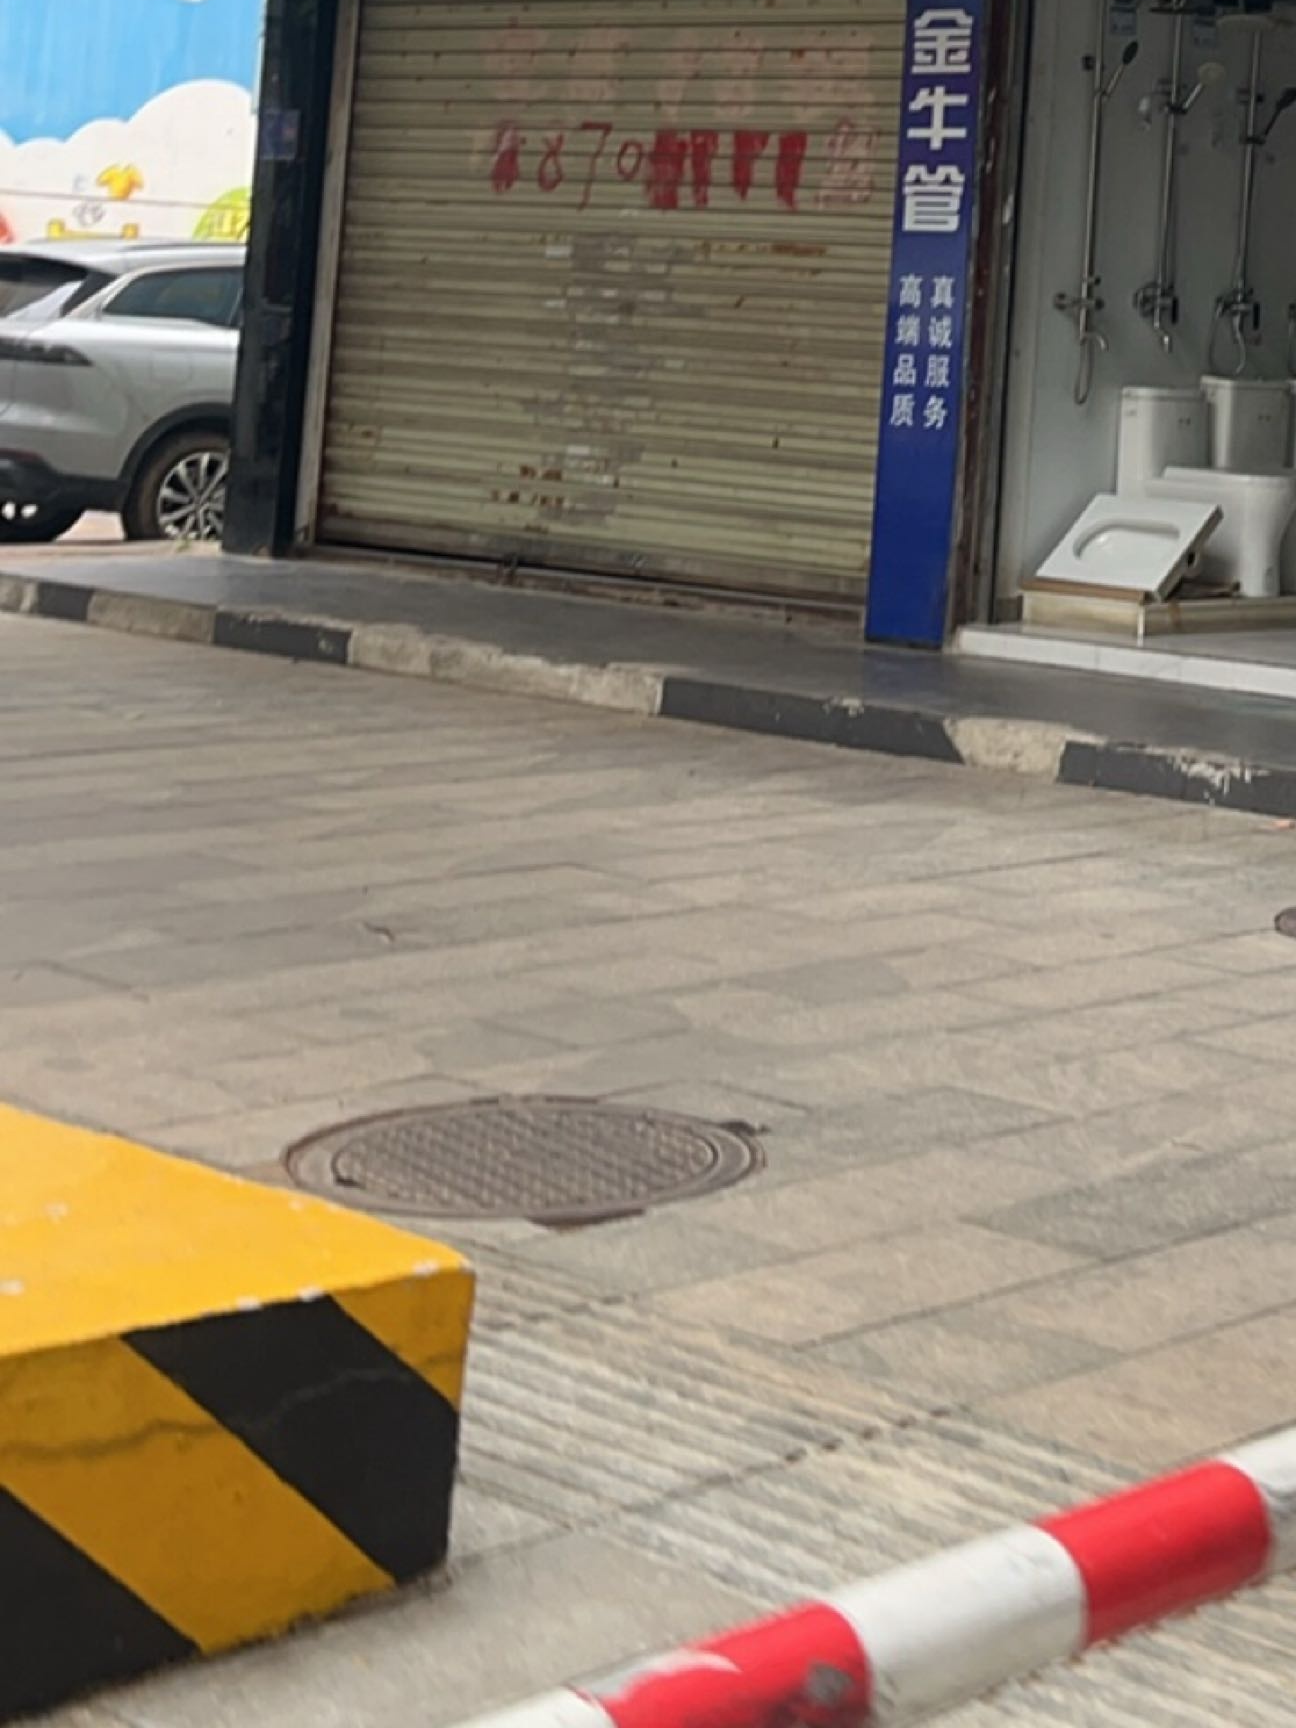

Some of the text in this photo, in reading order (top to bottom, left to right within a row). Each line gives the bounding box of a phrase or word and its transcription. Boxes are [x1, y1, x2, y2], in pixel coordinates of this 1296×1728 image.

[902, 8, 974, 233] 金牛管
[889, 273, 922, 427] 高端品质
[922, 275, 956, 431] 真诚服务
